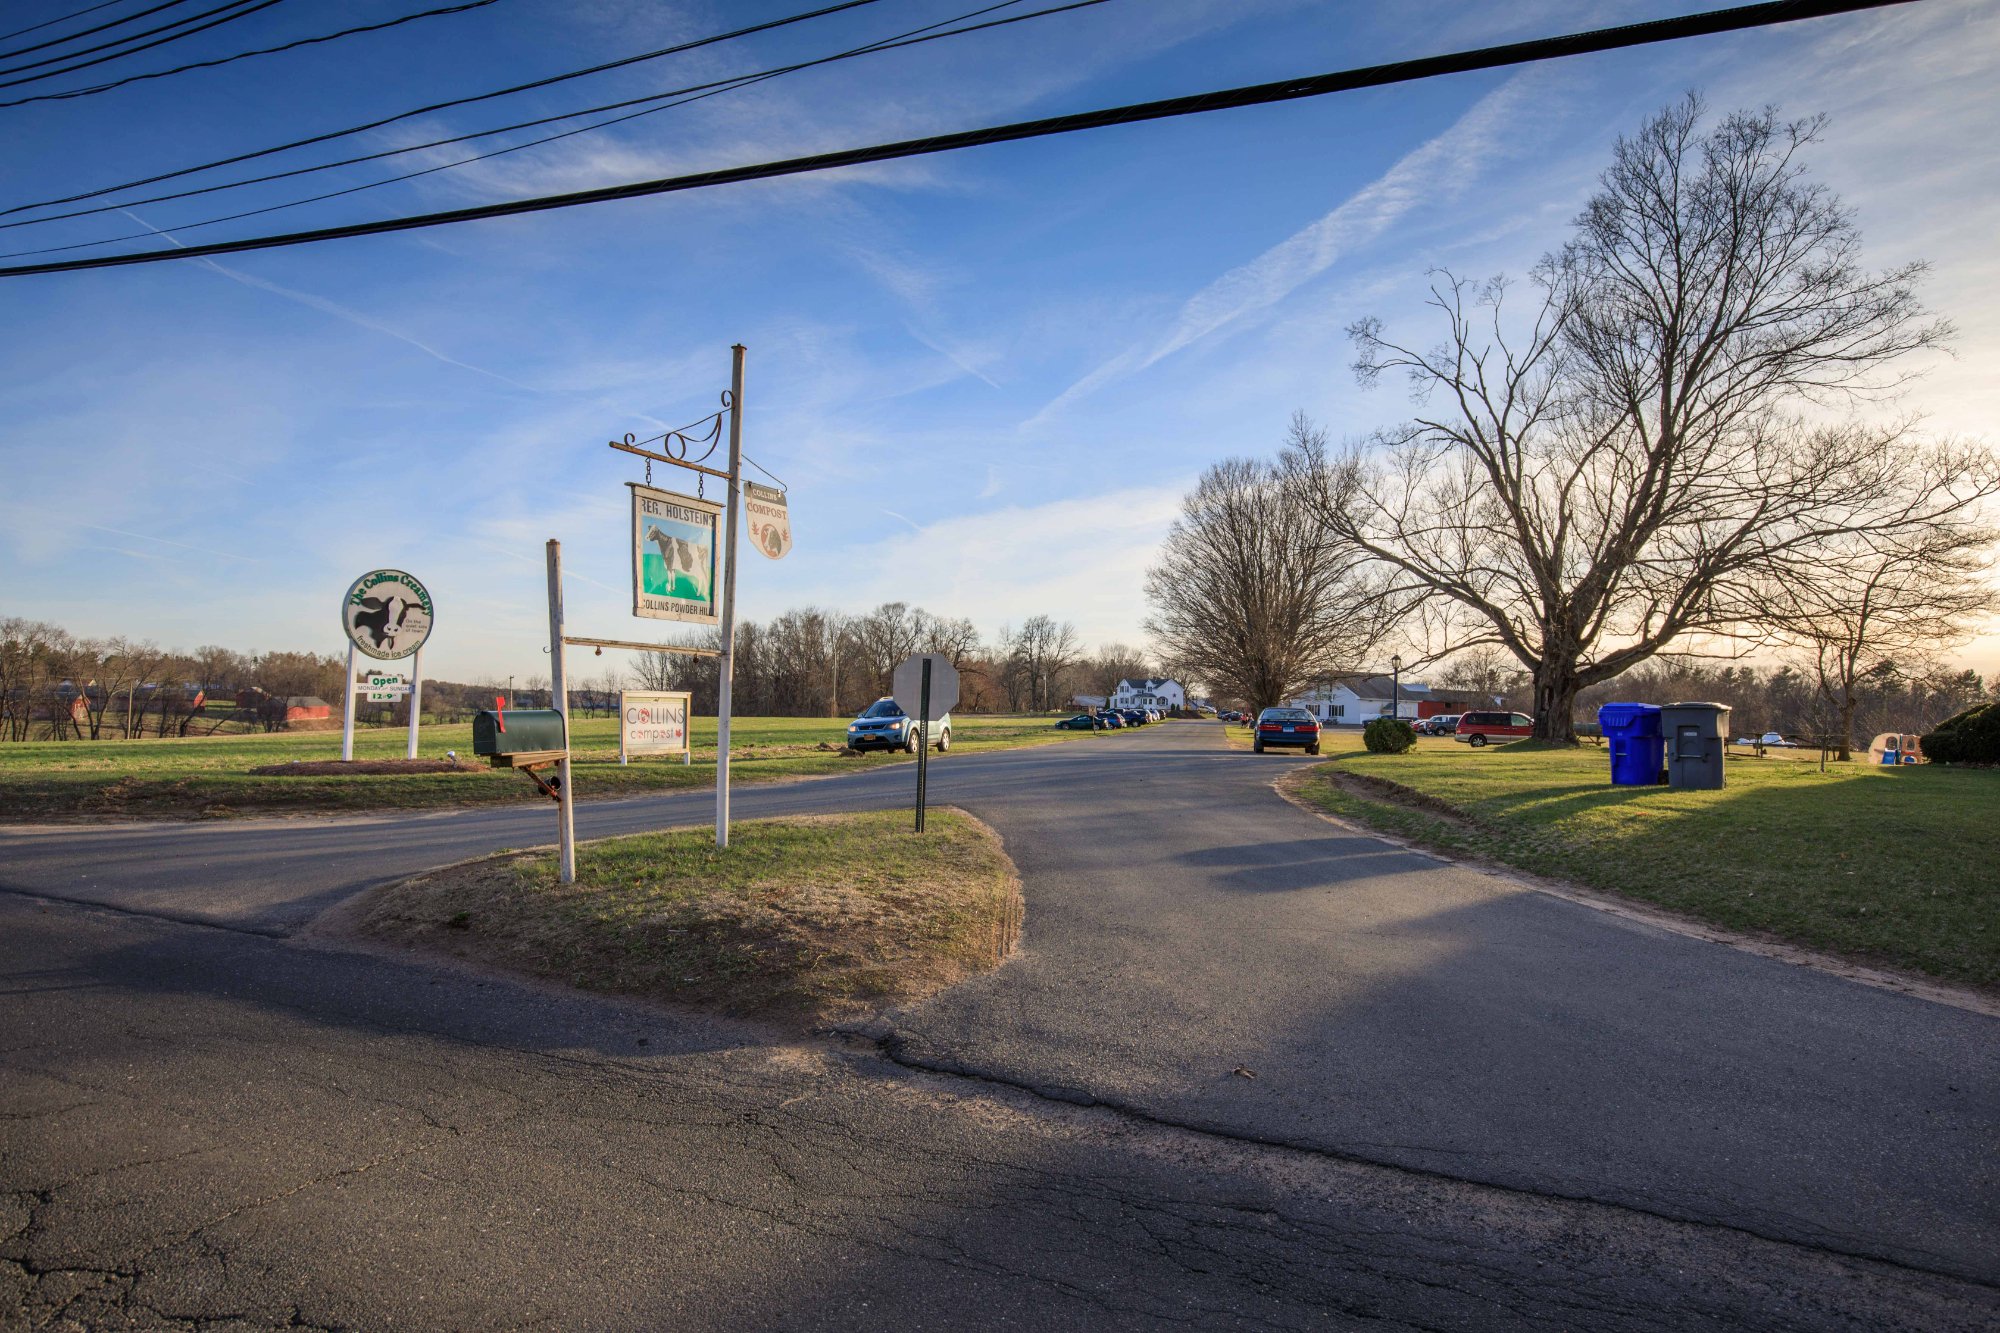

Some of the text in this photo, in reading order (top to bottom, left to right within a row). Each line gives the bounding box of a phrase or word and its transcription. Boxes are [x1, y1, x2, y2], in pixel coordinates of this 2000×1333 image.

[746, 502, 787, 520] COMPOST
[350, 572, 432, 616] The Collins Creamery
[671, 602, 698, 615] POWDER
[357, 635, 390, 658] freshmade
[403, 640, 422, 654] cream
[372, 677, 398, 687] Open
[626, 707, 685, 724] COLLINS
[630, 728, 674, 743] compost
